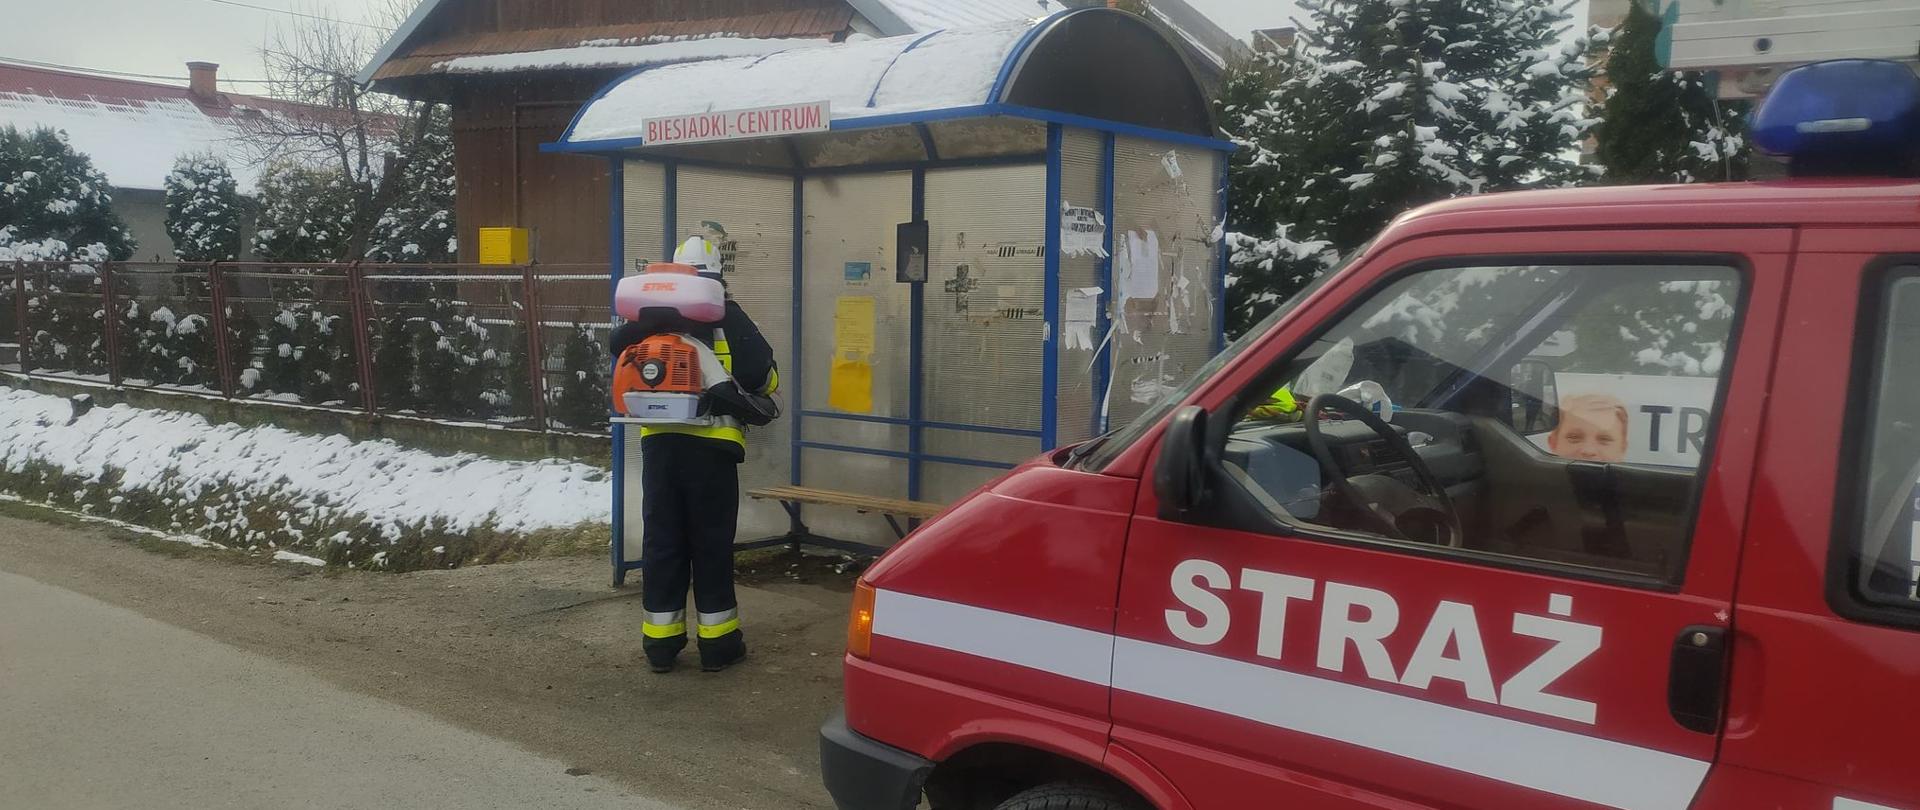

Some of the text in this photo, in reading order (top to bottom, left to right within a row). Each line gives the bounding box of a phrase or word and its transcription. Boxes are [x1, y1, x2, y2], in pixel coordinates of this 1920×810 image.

[648, 105, 821, 142] BIESIADKI-CENTRUM
[642, 282, 677, 292] STIHL
[1165, 559, 1603, 725] STRAŻ
